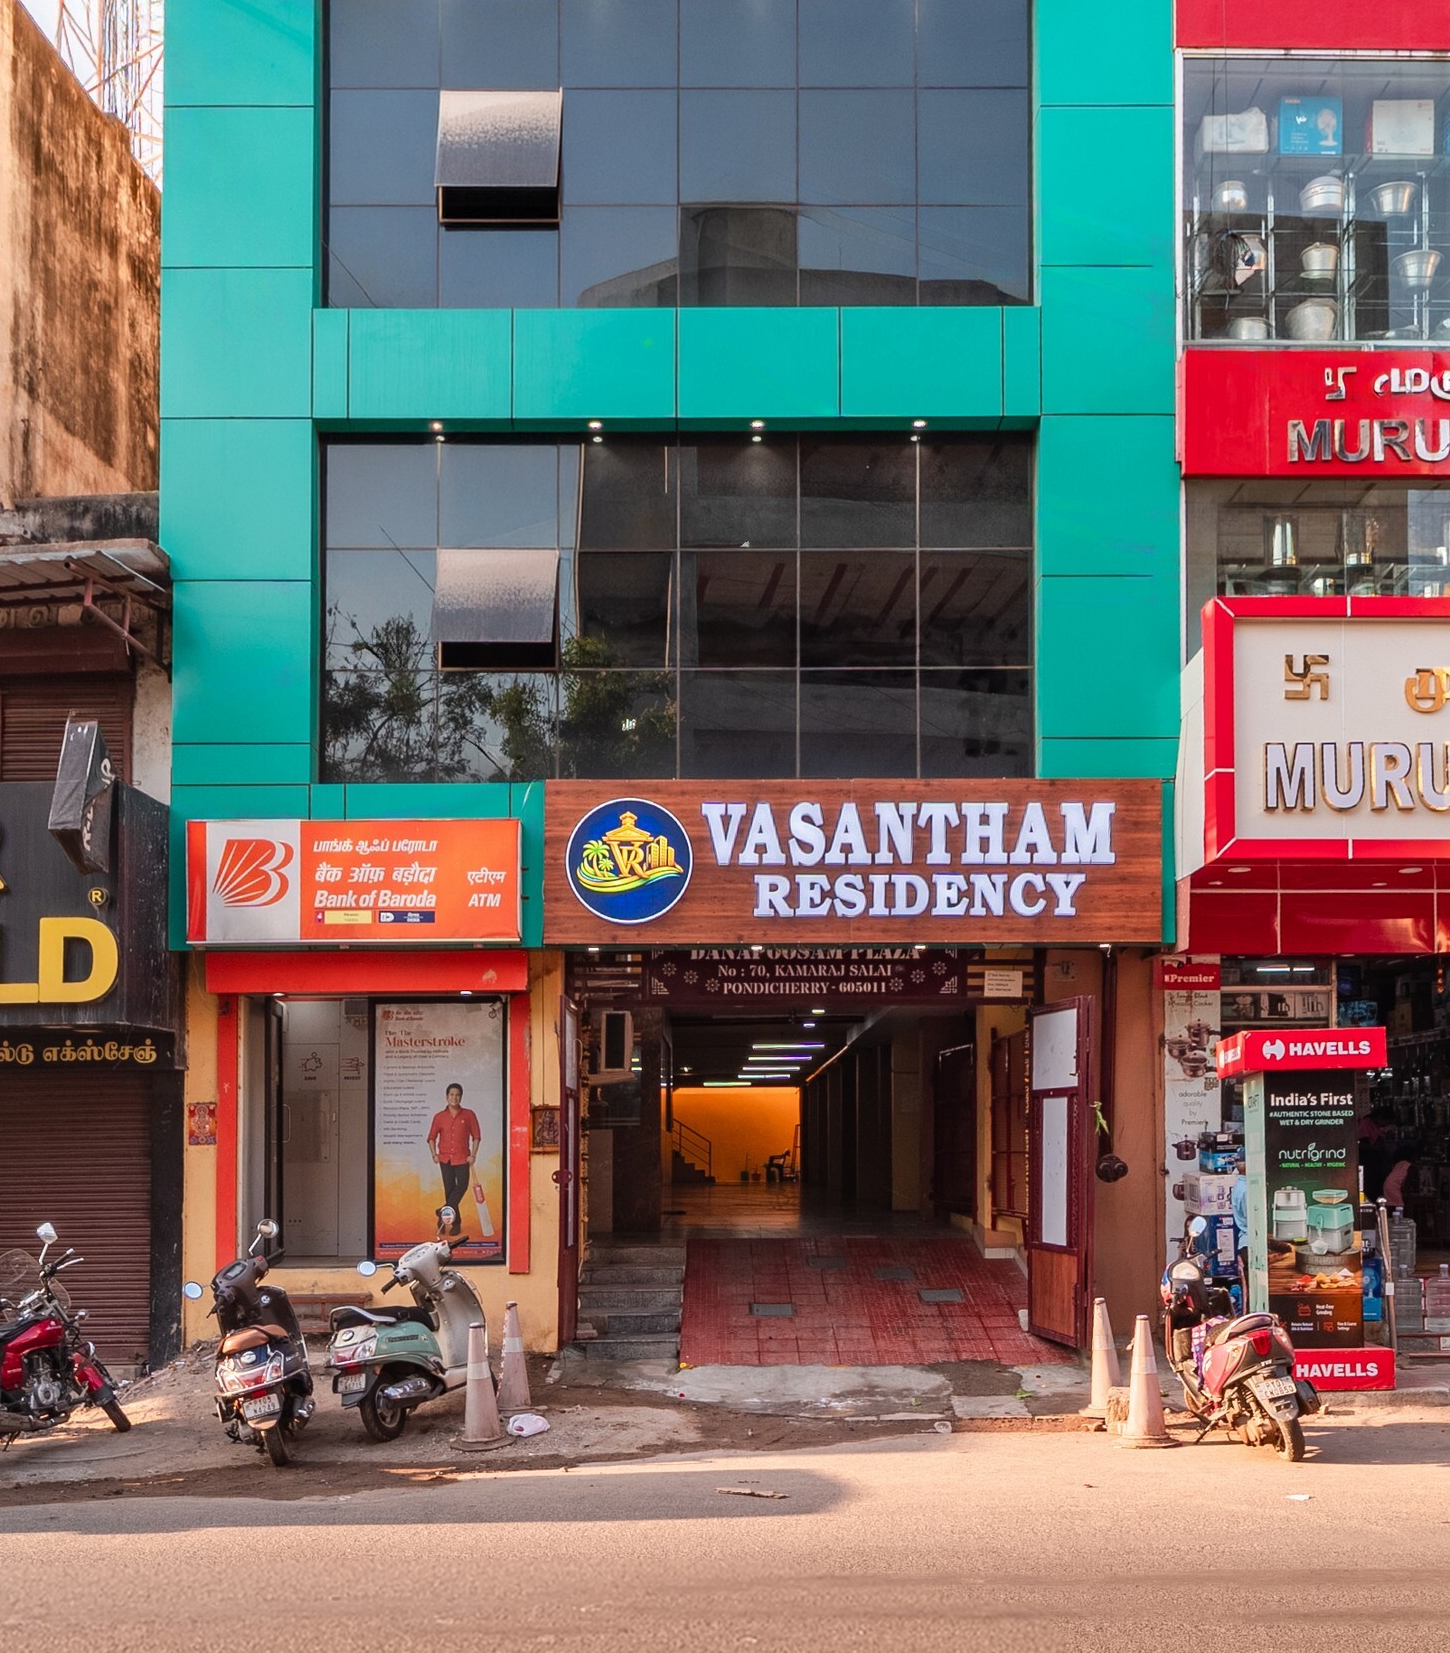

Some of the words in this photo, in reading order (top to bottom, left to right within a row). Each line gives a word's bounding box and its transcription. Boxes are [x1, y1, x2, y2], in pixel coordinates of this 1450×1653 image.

[700, 801, 1117, 867] VASANTHAM
[467, 867, 507, 885] एटीएम
[314, 890, 357, 907] Bank
[360, 889, 377, 907] of
[378, 889, 437, 907] Baroda
[468, 893, 502, 907] ATM
[753, 873, 1087, 918] RESIDENCY
[718, 965, 737, 977] No
[750, 965, 770, 979] 70,
[775, 964, 846, 977] KAMARAJ
[849, 964, 892, 976] SALAI
[1170, 975, 1215, 984] Premier
[723, 982, 830, 995] PONDICHERRY
[839, 981, 887, 993] 605011
[385, 1037, 465, 1047] Masterstroke
[1289, 1040, 1371, 1057] HAVELLS
[1320, 1093, 1353, 1106] First
[1278, 1146, 1346, 1162] nutrigrind
[1296, 1362, 1379, 1378] HAVELLS
